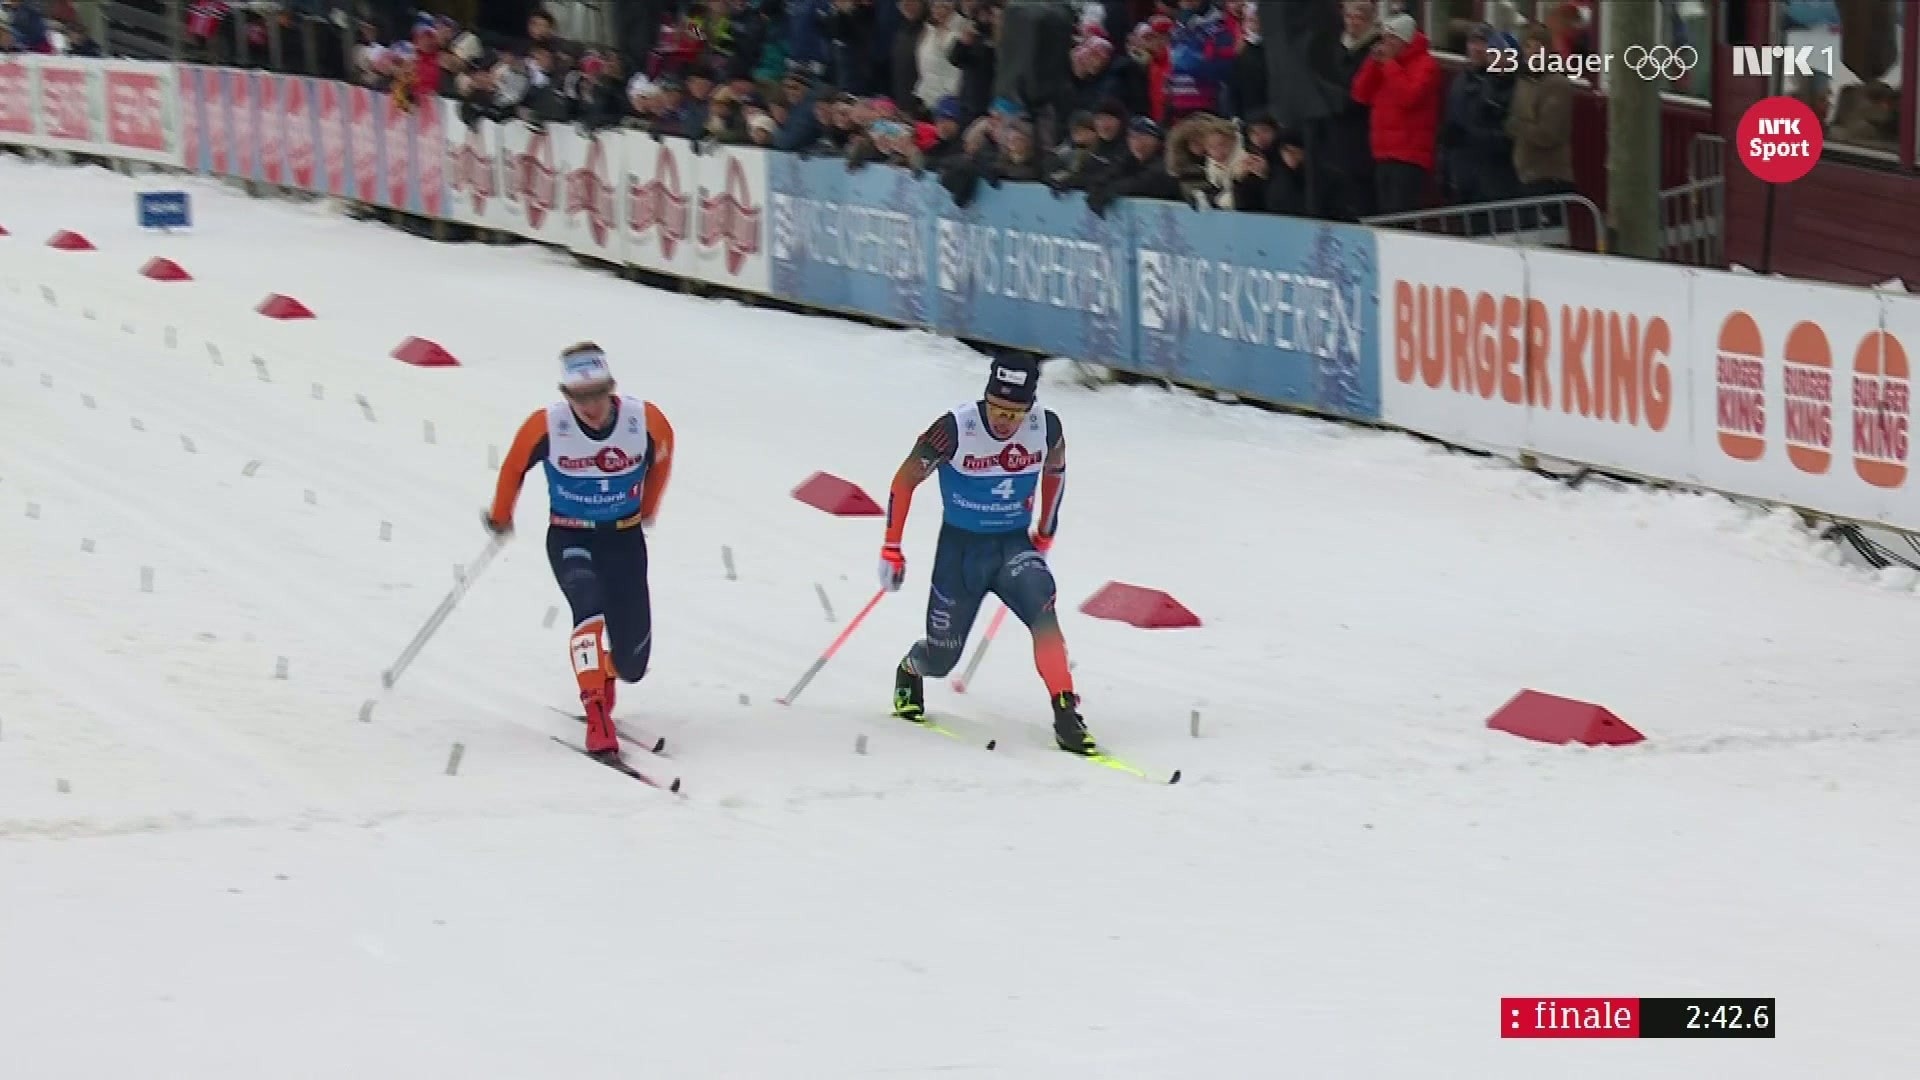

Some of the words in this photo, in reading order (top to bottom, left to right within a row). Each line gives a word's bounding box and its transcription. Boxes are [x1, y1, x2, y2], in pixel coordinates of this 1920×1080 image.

[1216, 260, 1362, 360] EKSPERTEN
[1394, 279, 1552, 410] BURGER
[1560, 303, 1672, 433] KING
[1717, 354, 1765, 390] BURGER
[1784, 365, 1832, 404] BURGER
[1853, 375, 1910, 415] BURGER
[1717, 387, 1766, 436] KING
[1785, 398, 1832, 448] KING
[1853, 410, 1909, 460] KING
[597, 479, 609, 493] 1
[991, 478, 1016, 500] 4
[581, 652, 589, 665] 1
